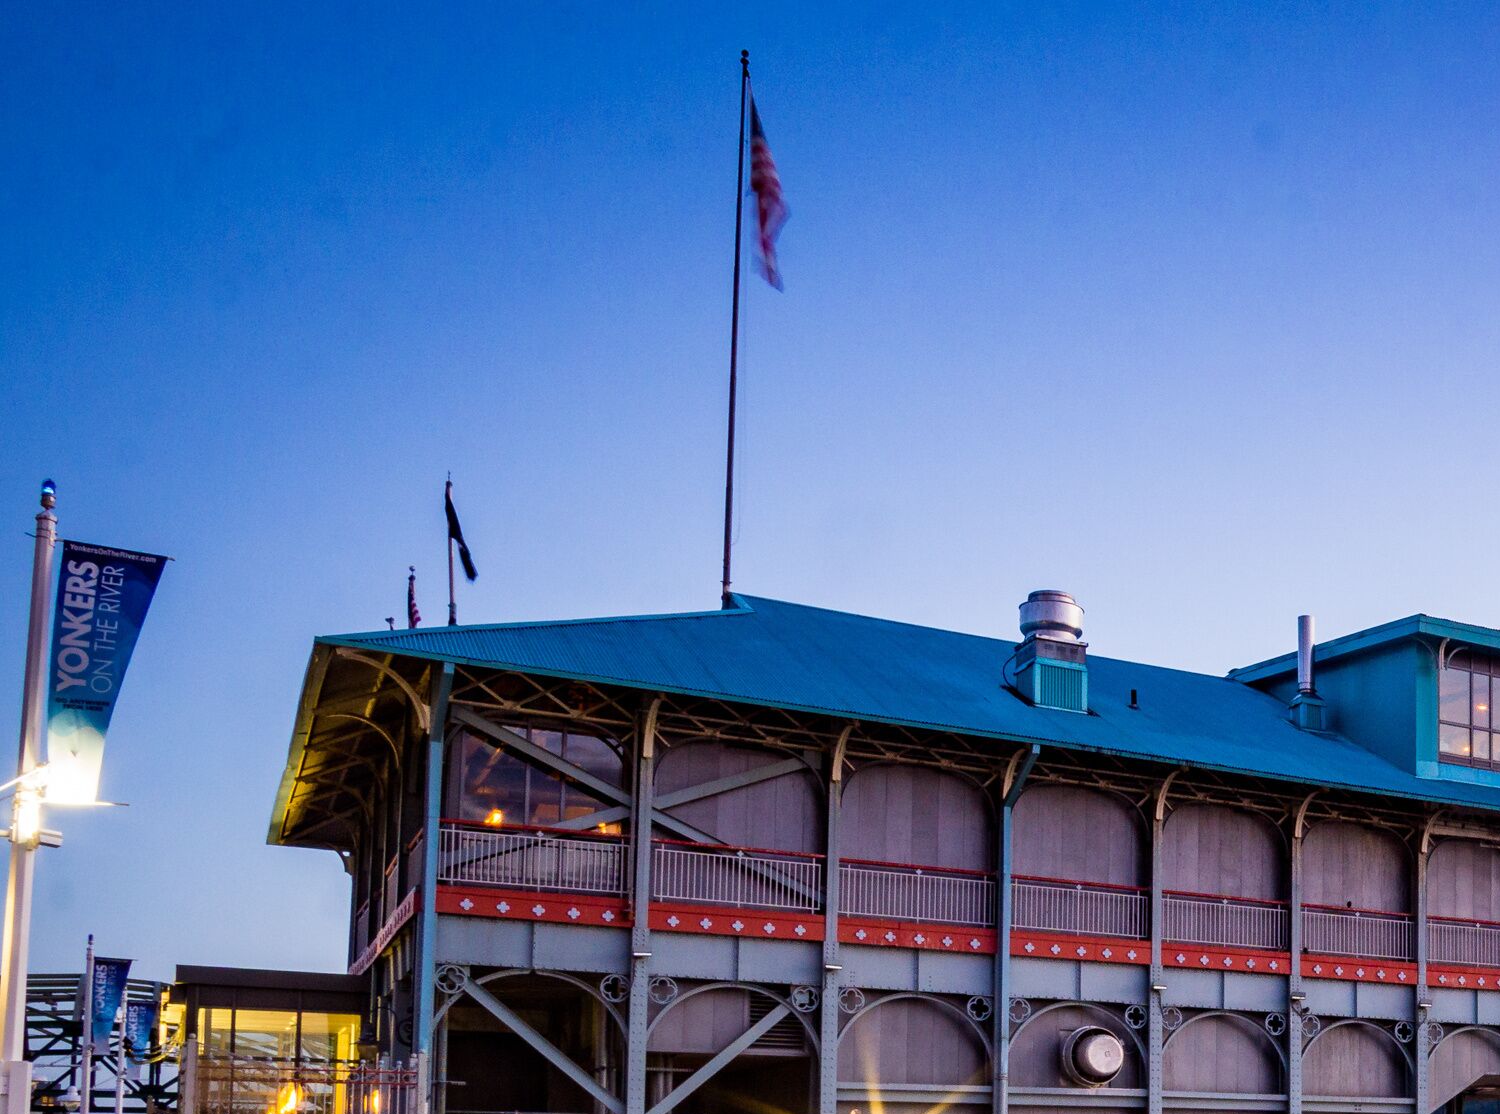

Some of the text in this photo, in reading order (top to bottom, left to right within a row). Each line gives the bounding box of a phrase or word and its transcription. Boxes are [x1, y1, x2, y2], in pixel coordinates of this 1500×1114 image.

[70, 544, 157, 563] YonkersOnTheRiver.com
[56, 560, 99, 691] YONKERS
[91, 565, 124, 693] ON THE RIVER
[96, 964, 108, 1015] YONKERS
[128, 1005, 138, 1041] ONKERS
